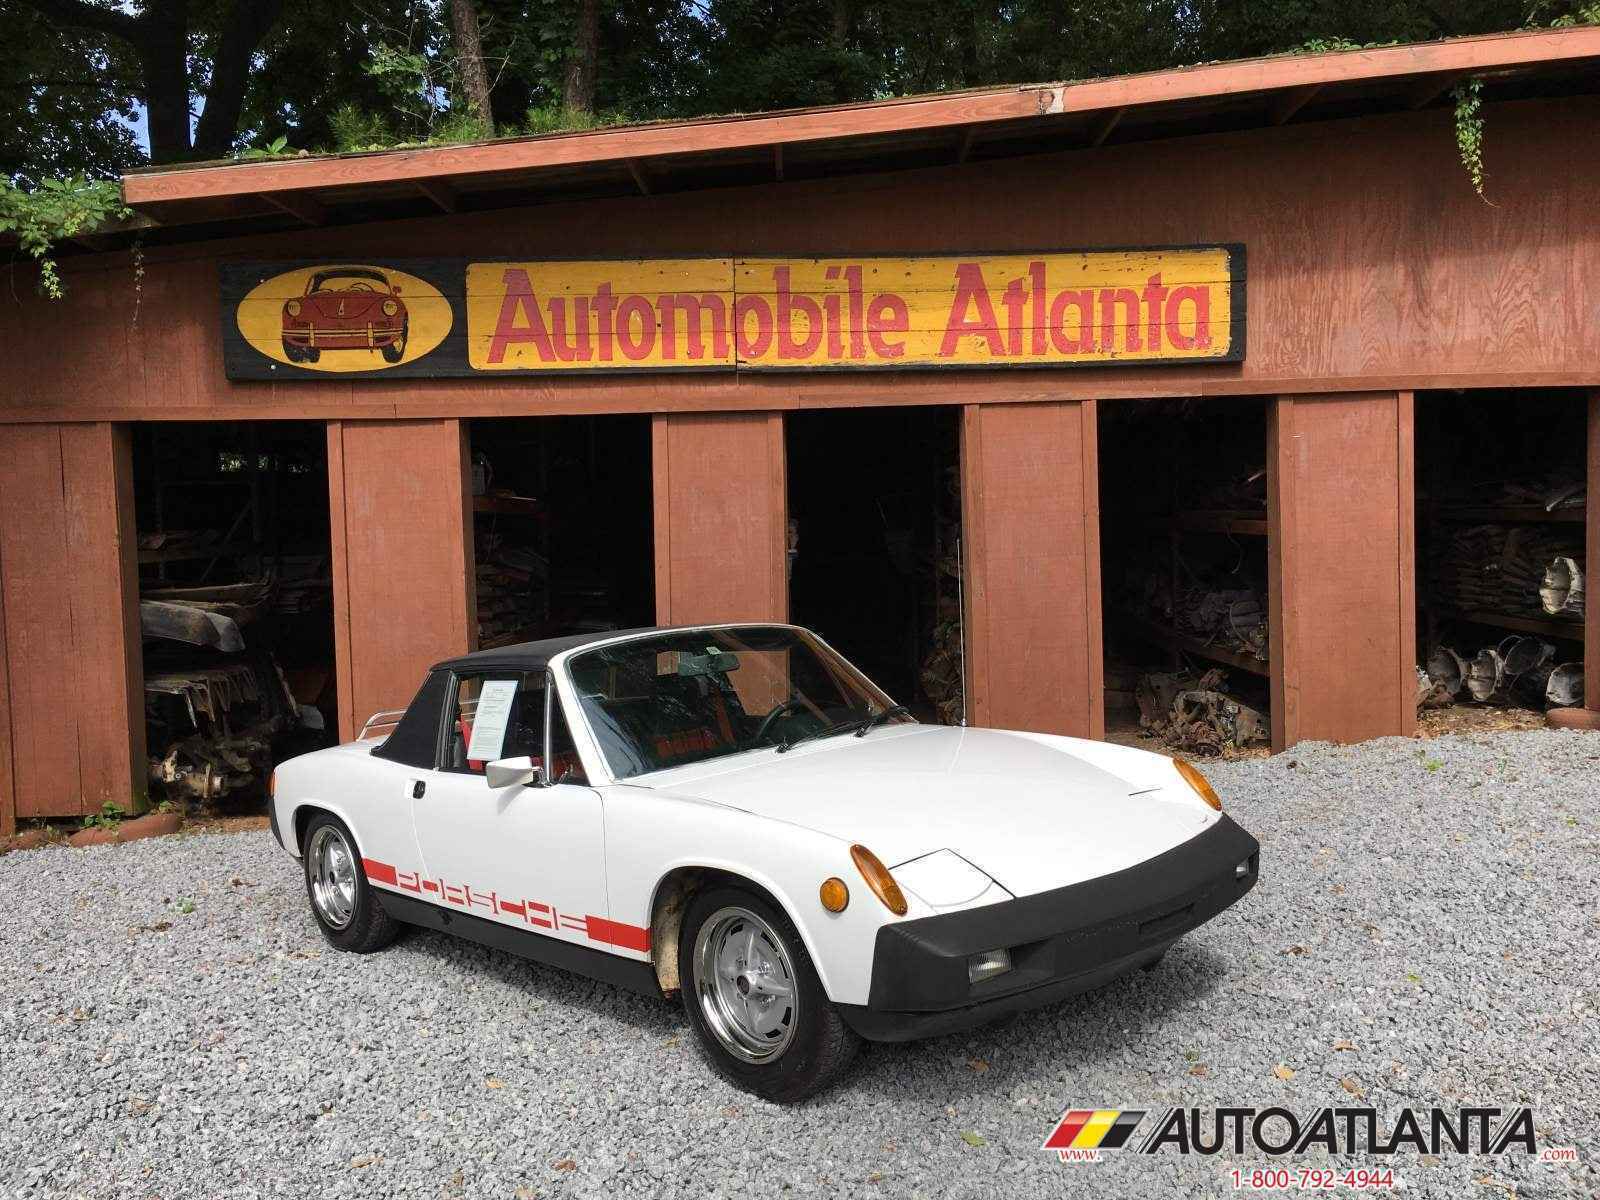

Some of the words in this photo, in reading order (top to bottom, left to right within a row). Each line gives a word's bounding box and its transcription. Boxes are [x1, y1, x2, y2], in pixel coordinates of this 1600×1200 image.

[487, 266, 909, 365] Automobile
[941, 261, 1210, 358] Atlanta
[397, 869, 587, 936] PORSCHE
